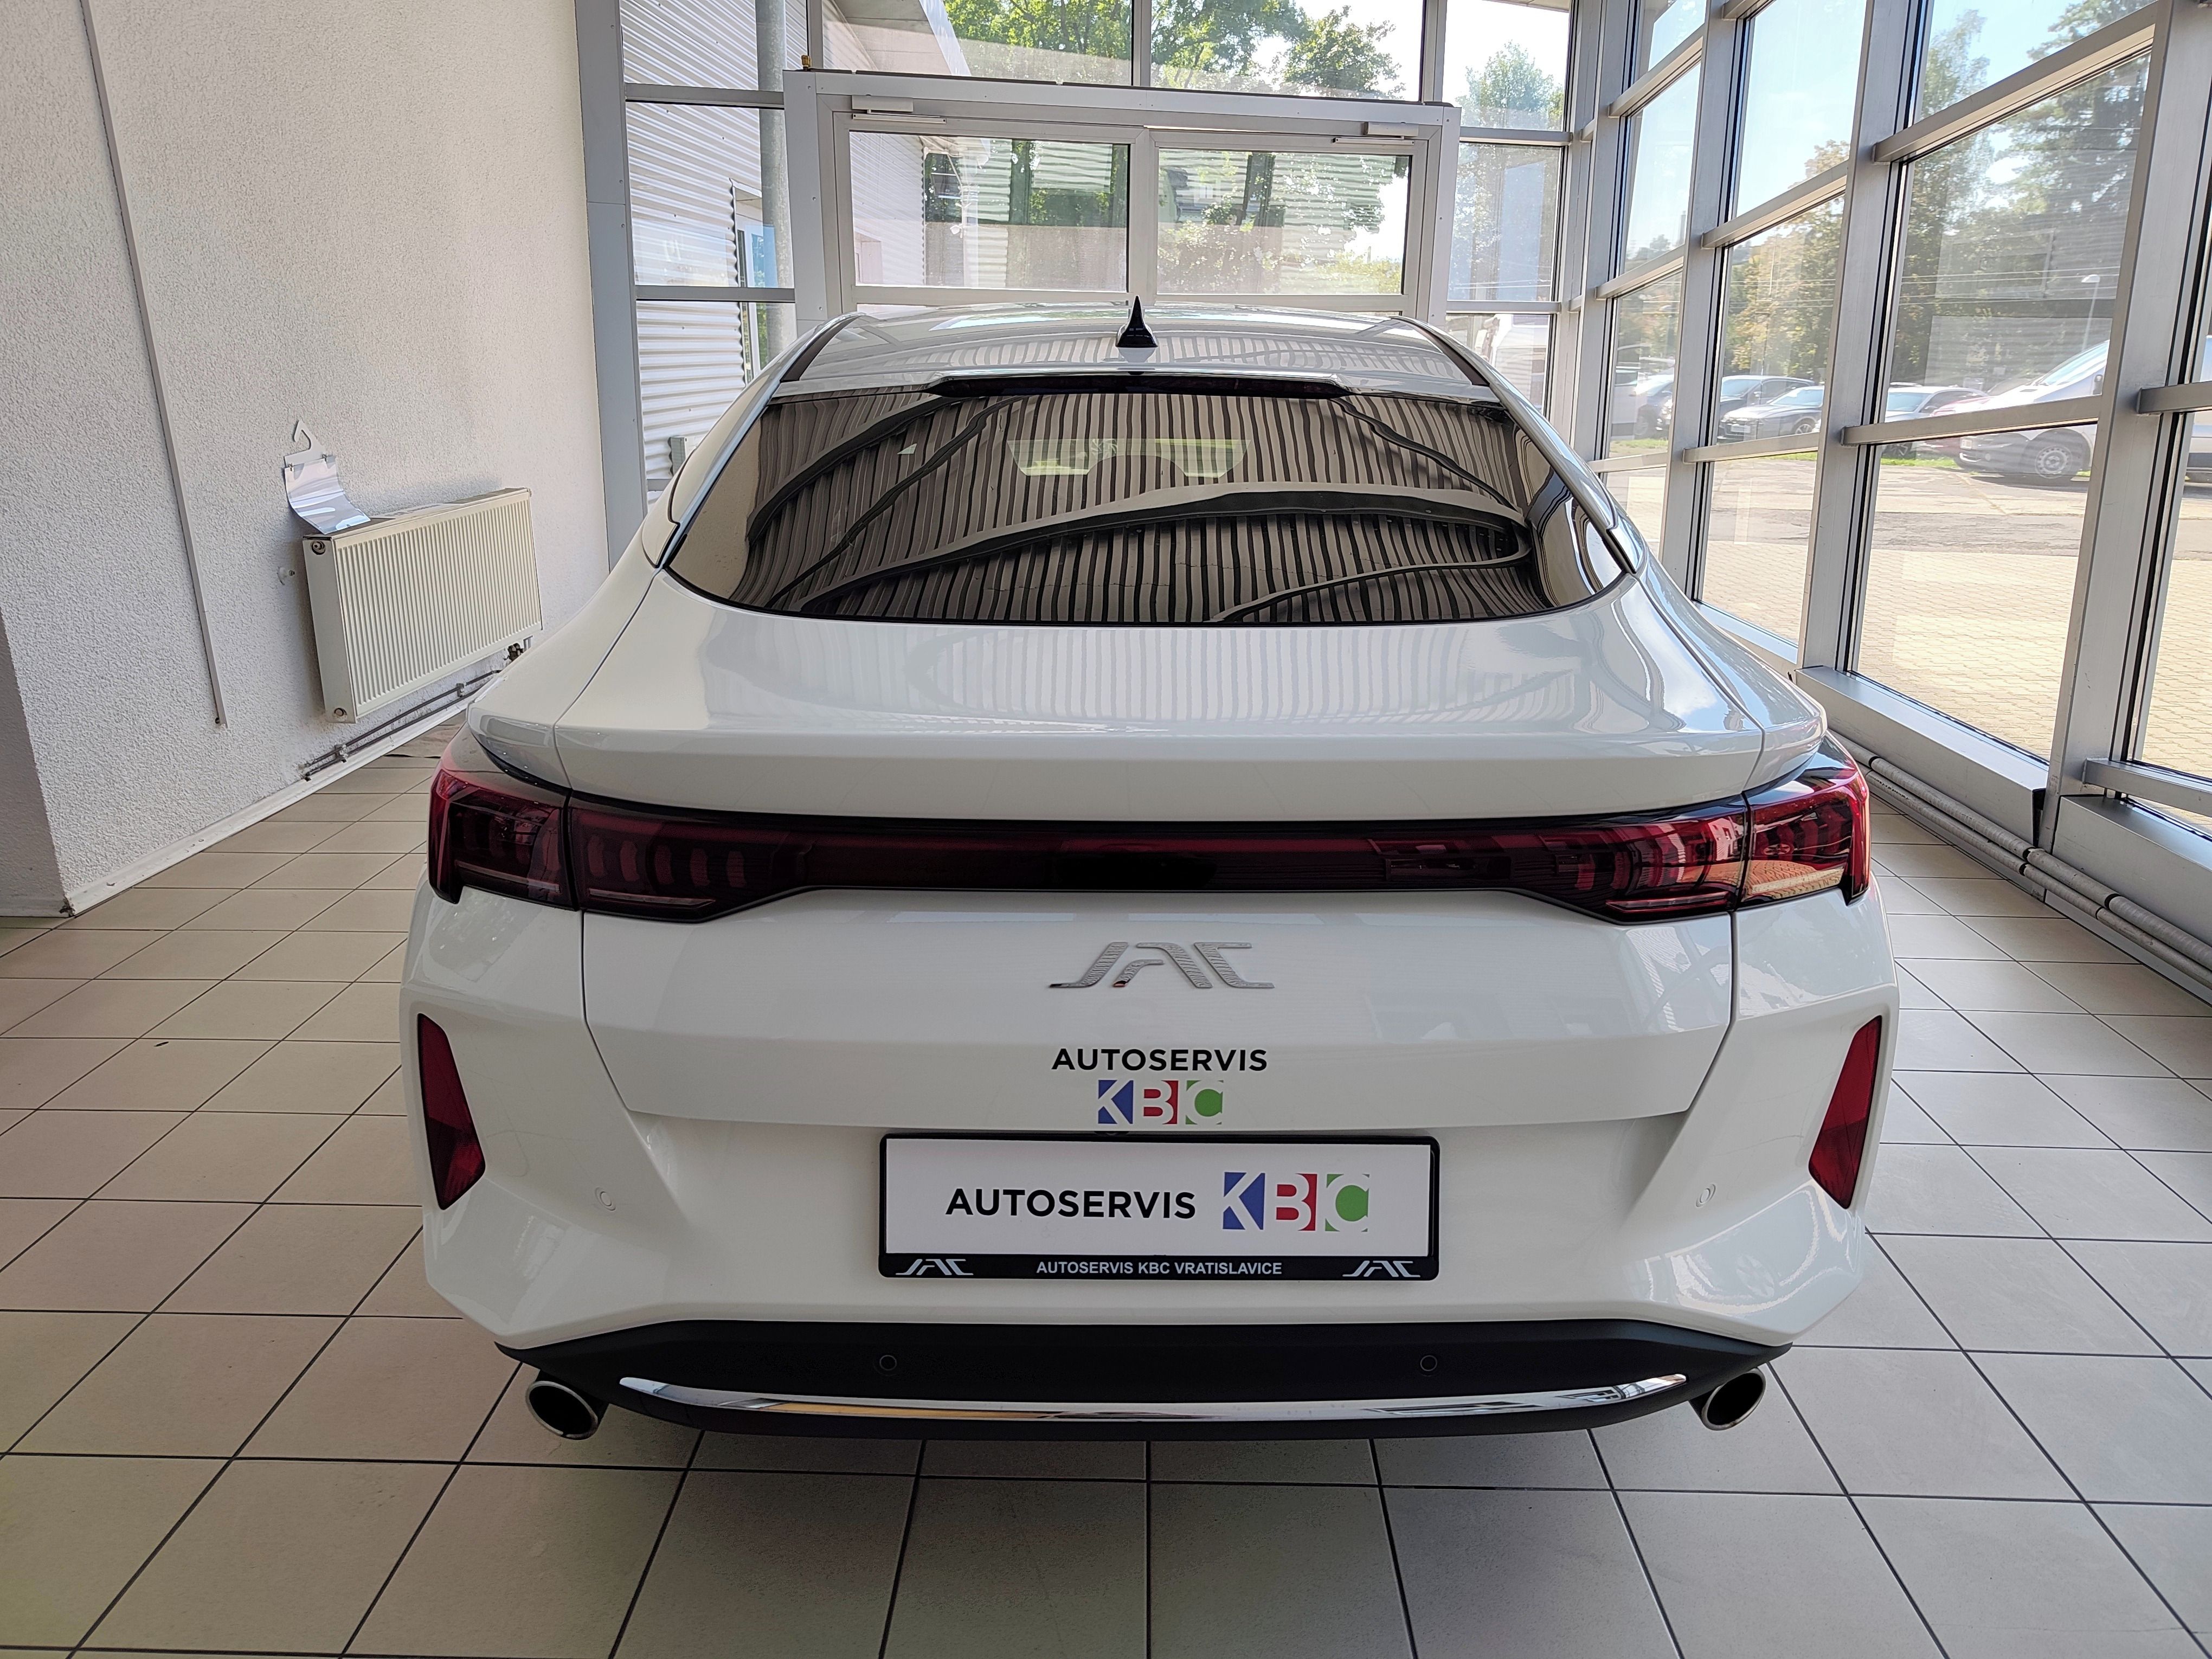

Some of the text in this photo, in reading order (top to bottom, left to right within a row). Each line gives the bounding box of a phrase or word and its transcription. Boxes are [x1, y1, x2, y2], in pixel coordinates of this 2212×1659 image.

[1049, 941, 1276, 989] JAC
[1051, 1048, 1268, 1072] AUTOSERVIS
[1097, 1079, 1223, 1125] KBC
[945, 1172, 1370, 1232] AUTOSERVIS KBC
[895, 1258, 974, 1276] JAC
[1036, 1261, 1282, 1275] AUTOSERVIS KBC VRATISLAVICE
[1342, 1259, 1421, 1278] JAC
